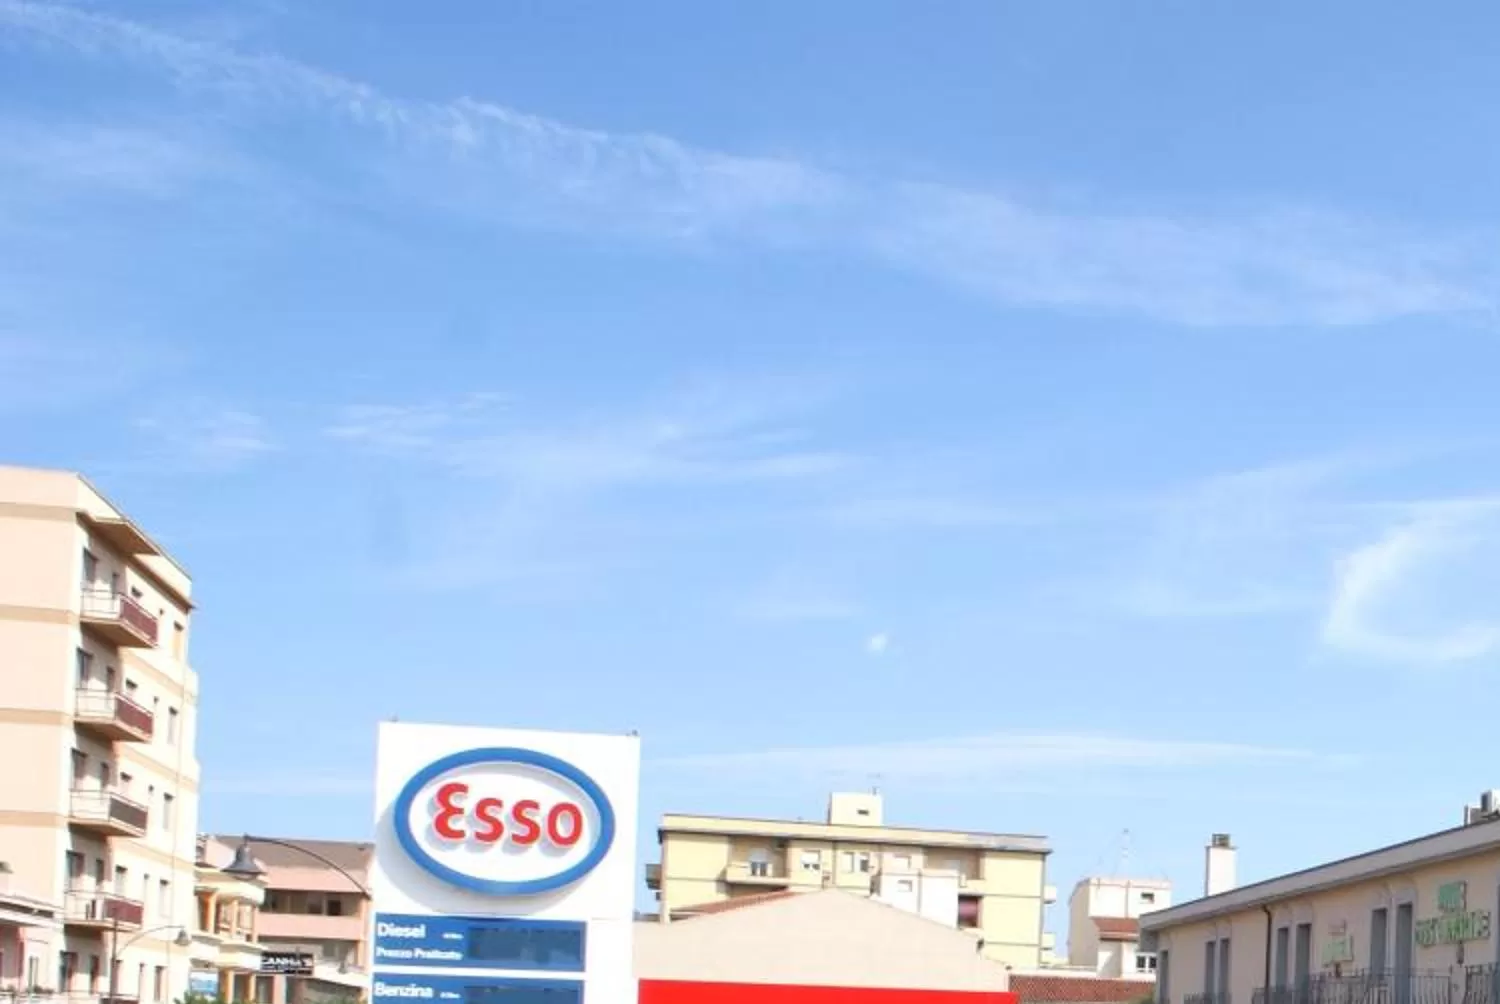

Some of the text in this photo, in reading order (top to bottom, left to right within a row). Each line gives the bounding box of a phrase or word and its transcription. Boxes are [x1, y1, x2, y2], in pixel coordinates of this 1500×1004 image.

[433, 782, 584, 848] Esso
[377, 921, 426, 938] Diesel
[374, 981, 433, 998] Benzina
